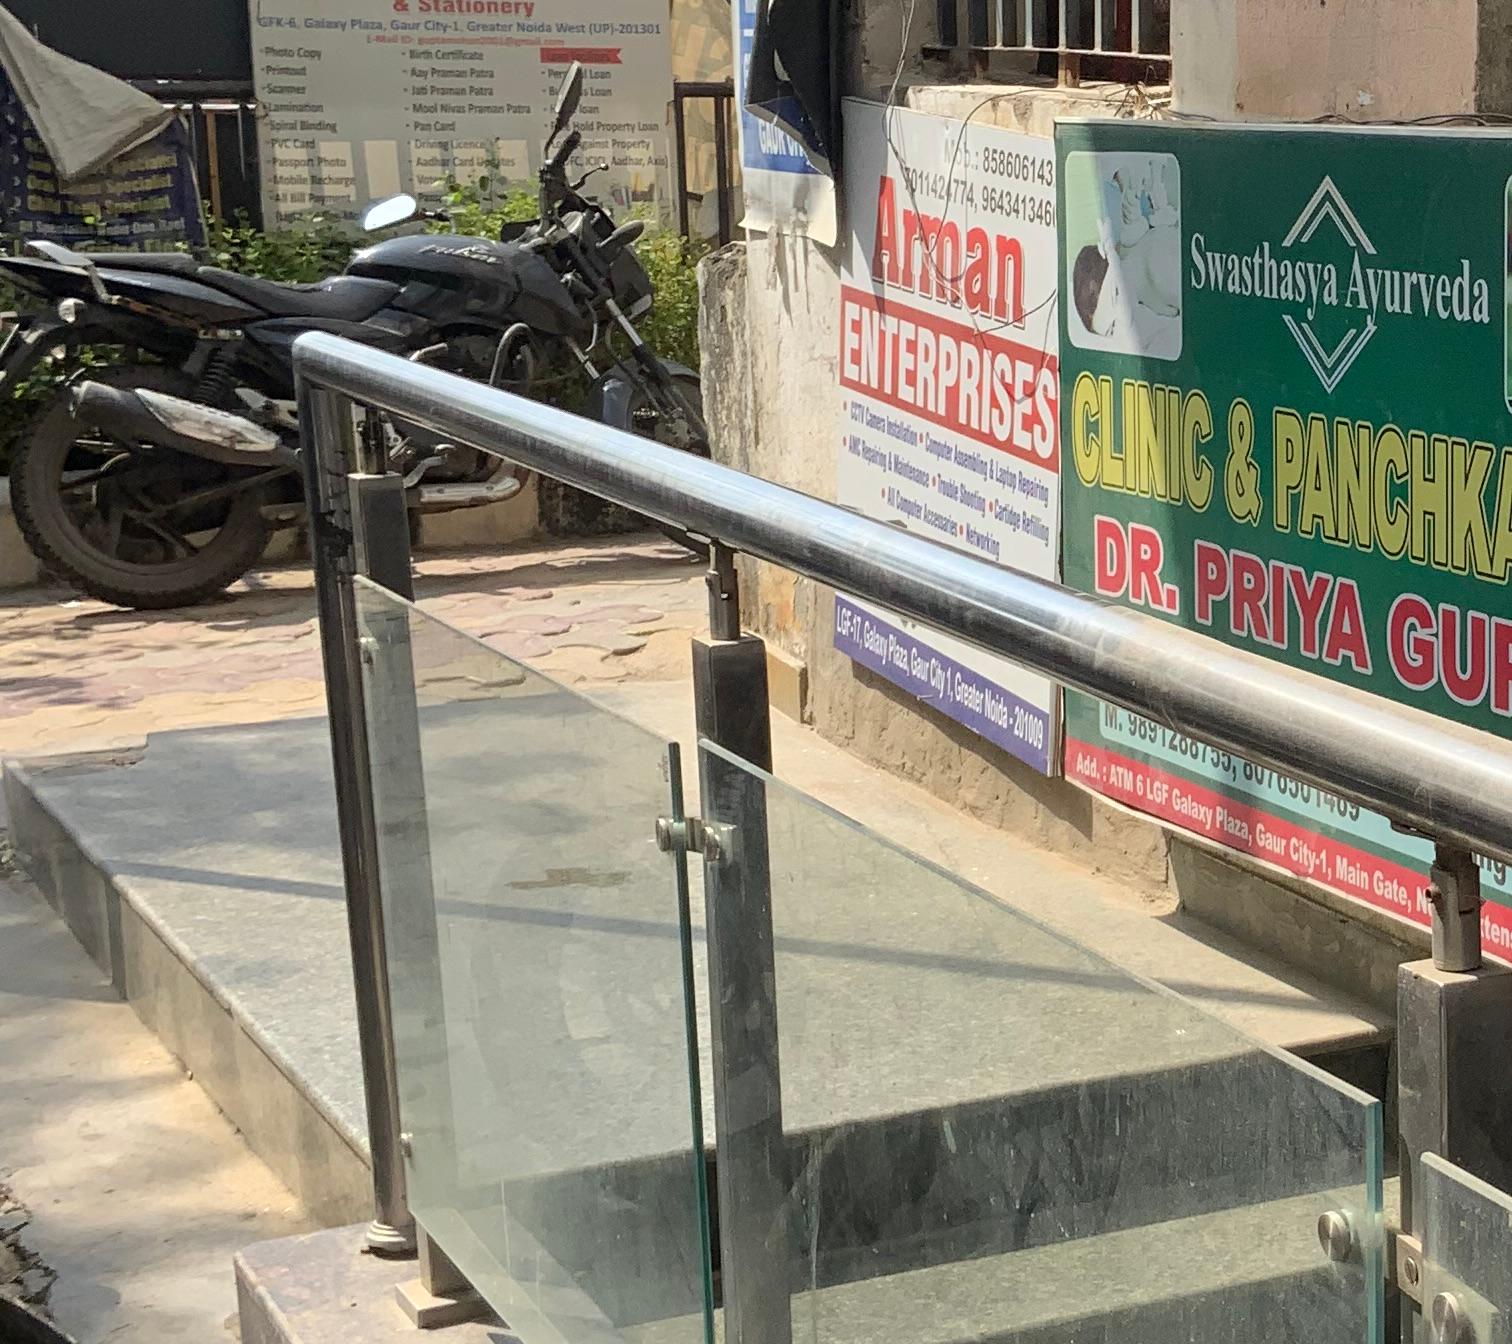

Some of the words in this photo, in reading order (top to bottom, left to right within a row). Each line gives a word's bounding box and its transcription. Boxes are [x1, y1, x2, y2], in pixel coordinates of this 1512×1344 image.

[304, 18, 347, 31] Galaxy
[390, 20, 423, 31] Gaur
[467, 21, 512, 32] Greater
[516, 22, 552, 33] Noida
[556, 23, 585, 34] West
[983, 146, 1055, 187] 858606143
[872, 176, 1025, 330] Arman
[1190, 233, 1339, 308] Swasthasya
[1344, 250, 1491, 326] Ayurveda
[844, 300, 1057, 458] ENTERPRISES
[1071, 369, 1213, 512] CLINIC
[1224, 398, 1263, 525] &
[1094, 514, 1180, 615] DR.
[1195, 538, 1372, 676] PRIYA
[864, 621, 887, 664] Galaxy
[889, 631, 909, 676] Plaza,
[911, 647, 928, 682] Gaur
[930, 658, 945, 697] City
[955, 672, 983, 713] Greater
[985, 690, 1008, 728] Noida
[1110, 765, 1134, 790] ATM
[1136, 778, 1144, 796] 6
[1146, 784, 1168, 806] LGF
[1172, 788, 1212, 830] Galaxy
[1216, 810, 1252, 847] Plaza,
[1256, 827, 1286, 856] Gaur
[1289, 837, 1332, 880] City-1,
[1336, 857, 1369, 892] Main
[1373, 870, 1411, 911] Gate,
